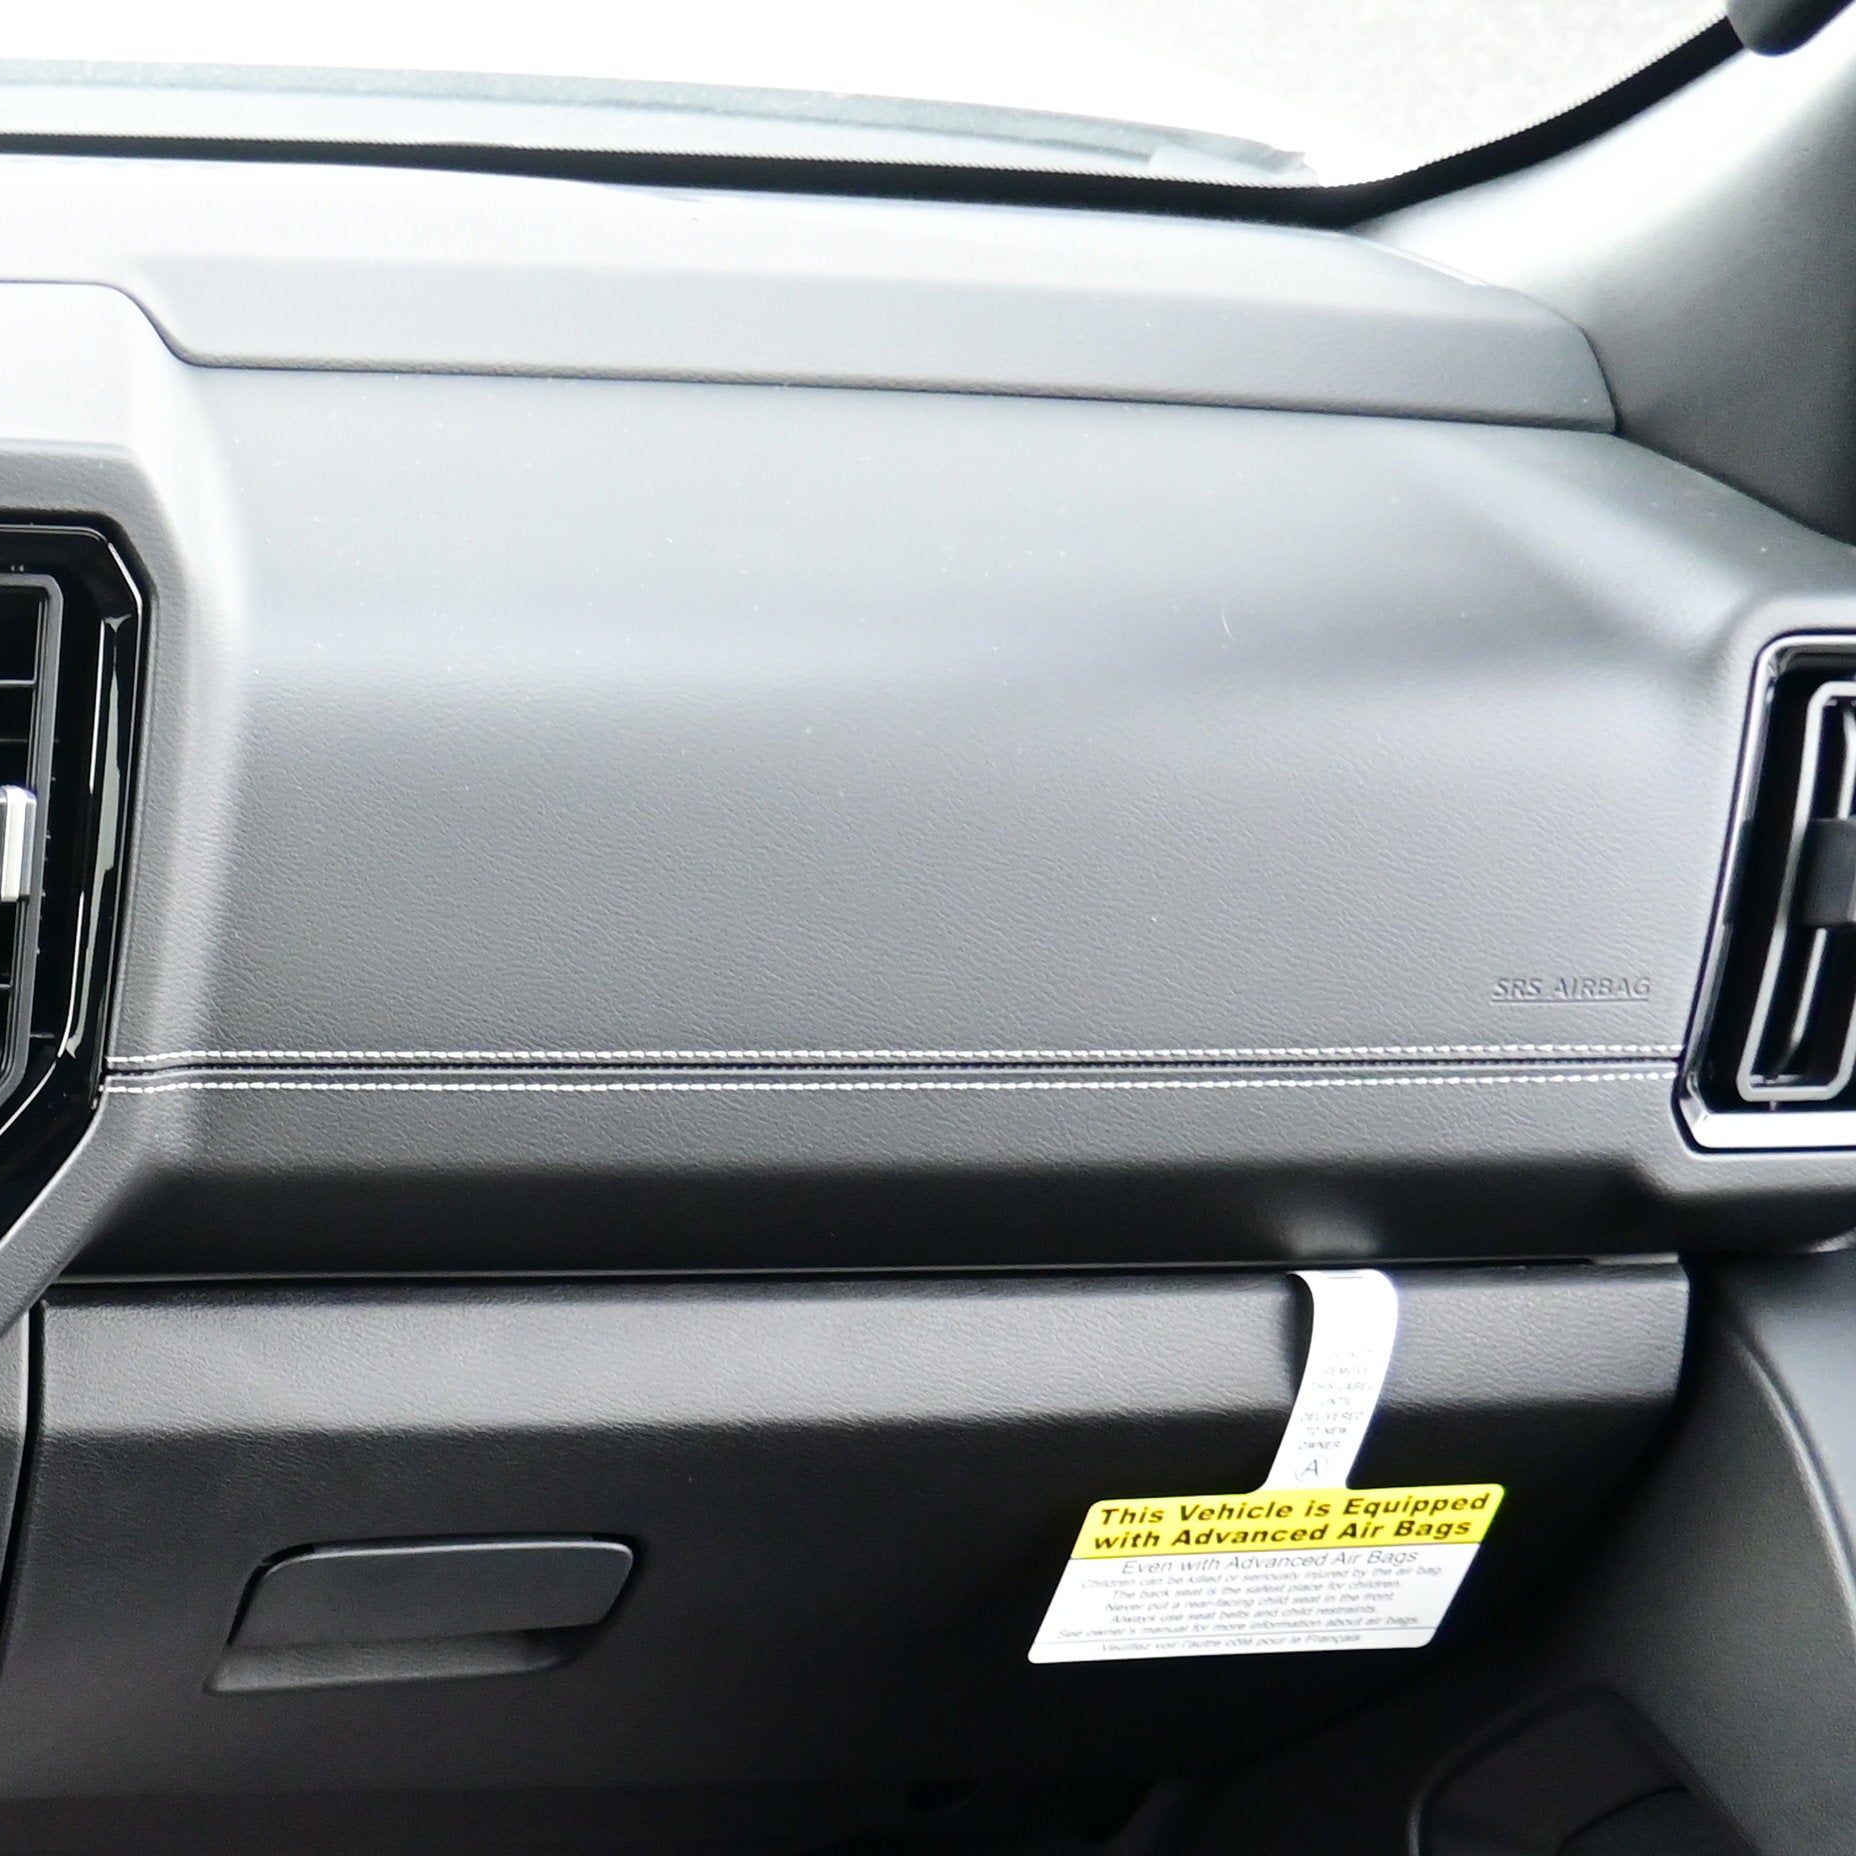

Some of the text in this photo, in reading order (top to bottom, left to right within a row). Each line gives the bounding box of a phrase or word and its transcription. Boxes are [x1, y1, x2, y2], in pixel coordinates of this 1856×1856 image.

[1493, 976, 1652, 999] SRS AIRBAG
[1100, 1493, 1491, 1526] This Vehicle is Equipped
[1093, 1520, 1473, 1550] with Advanced Air Bags
[1122, 1549, 1419, 1574] Even with Advanced Air Bags
